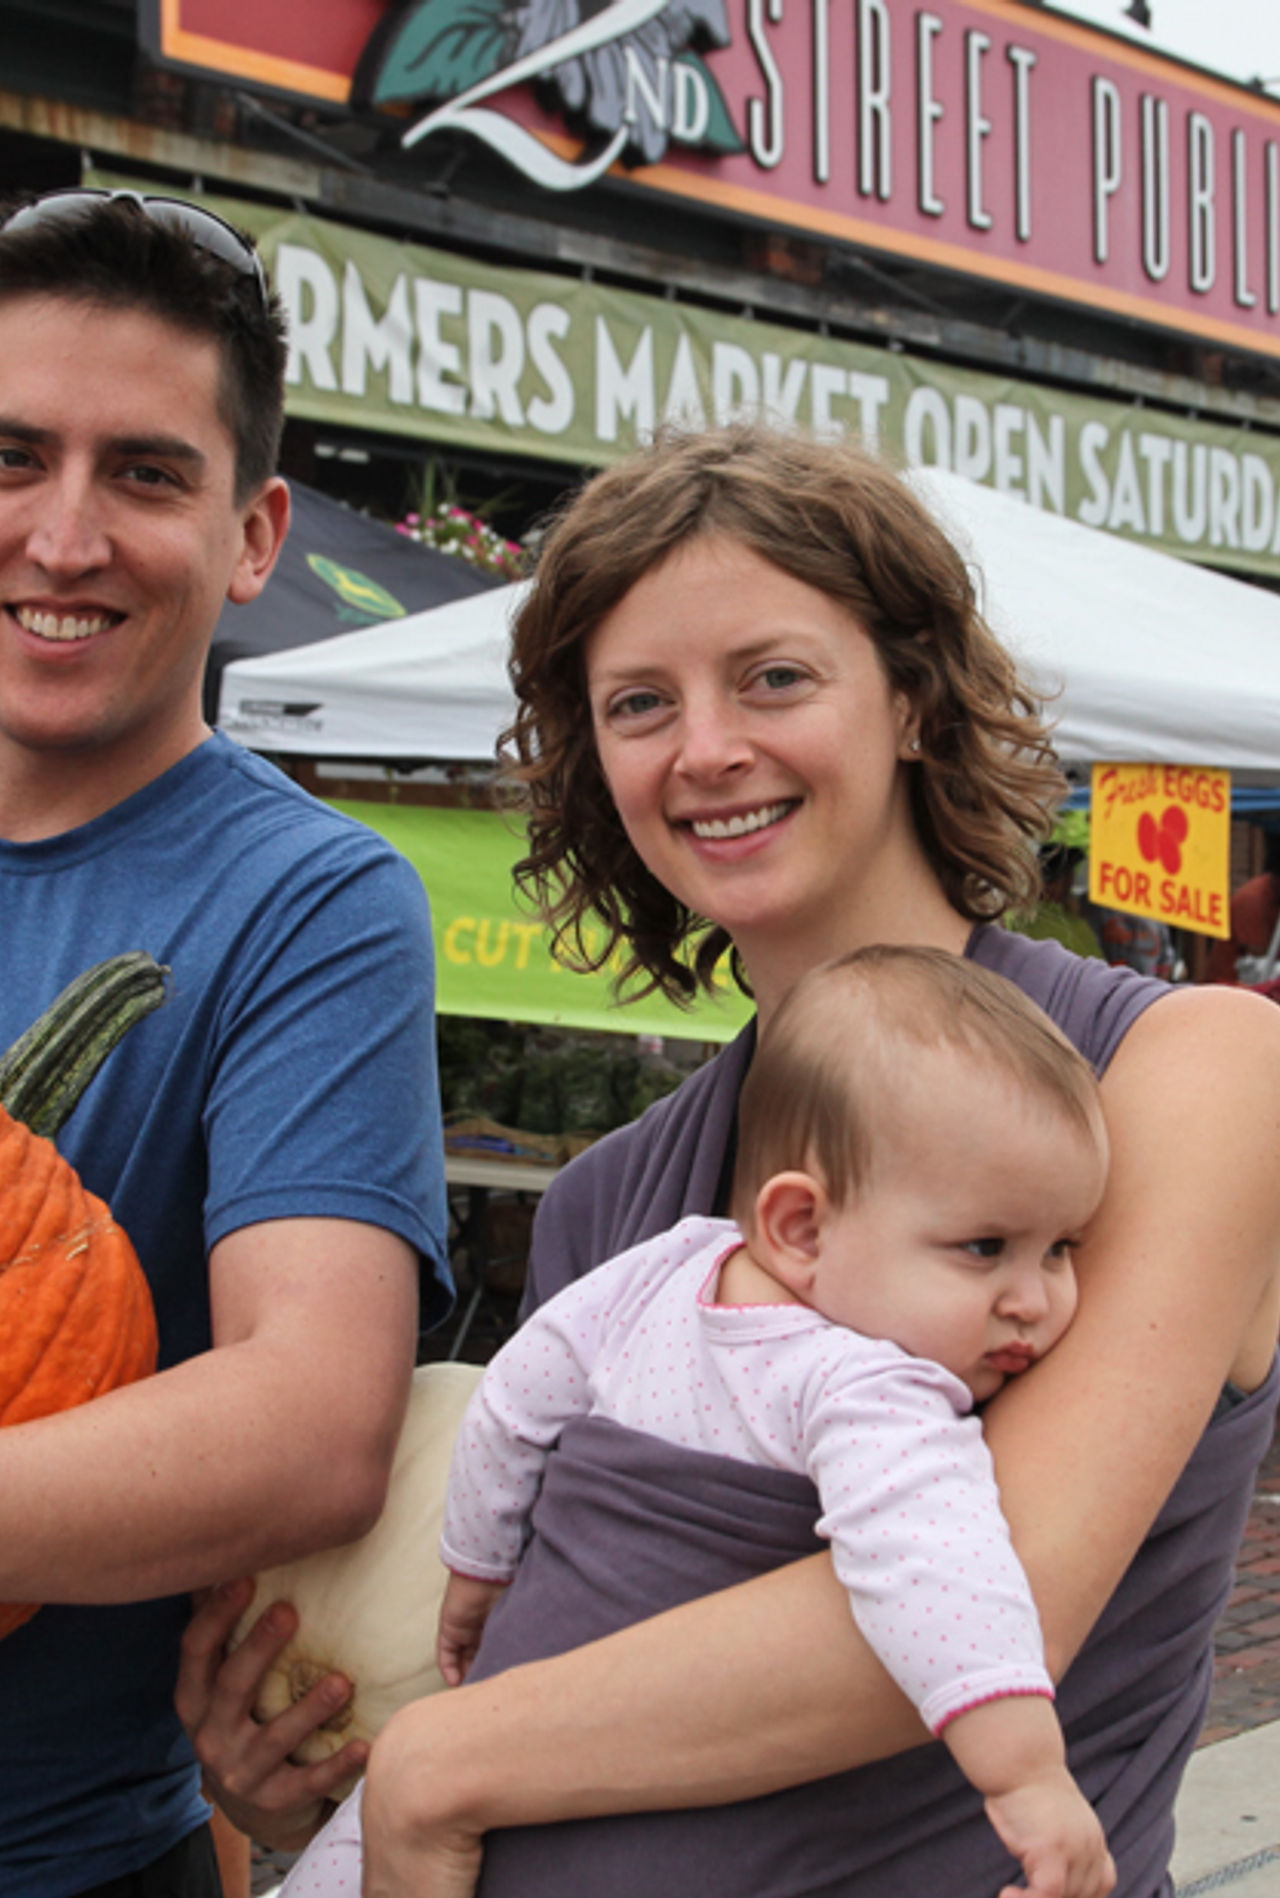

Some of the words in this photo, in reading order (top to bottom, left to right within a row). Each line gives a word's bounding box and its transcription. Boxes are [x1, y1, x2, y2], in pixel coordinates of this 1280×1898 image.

[746, 0, 1037, 241] STREET
[274, 243, 575, 436] RMERS
[904, 385, 1065, 519] OPEN
[1163, 764, 1225, 813] EGGS
[1099, 861, 1152, 908] FOR
[1159, 876, 1223, 927] SALE
[443, 916, 543, 969] CUT
